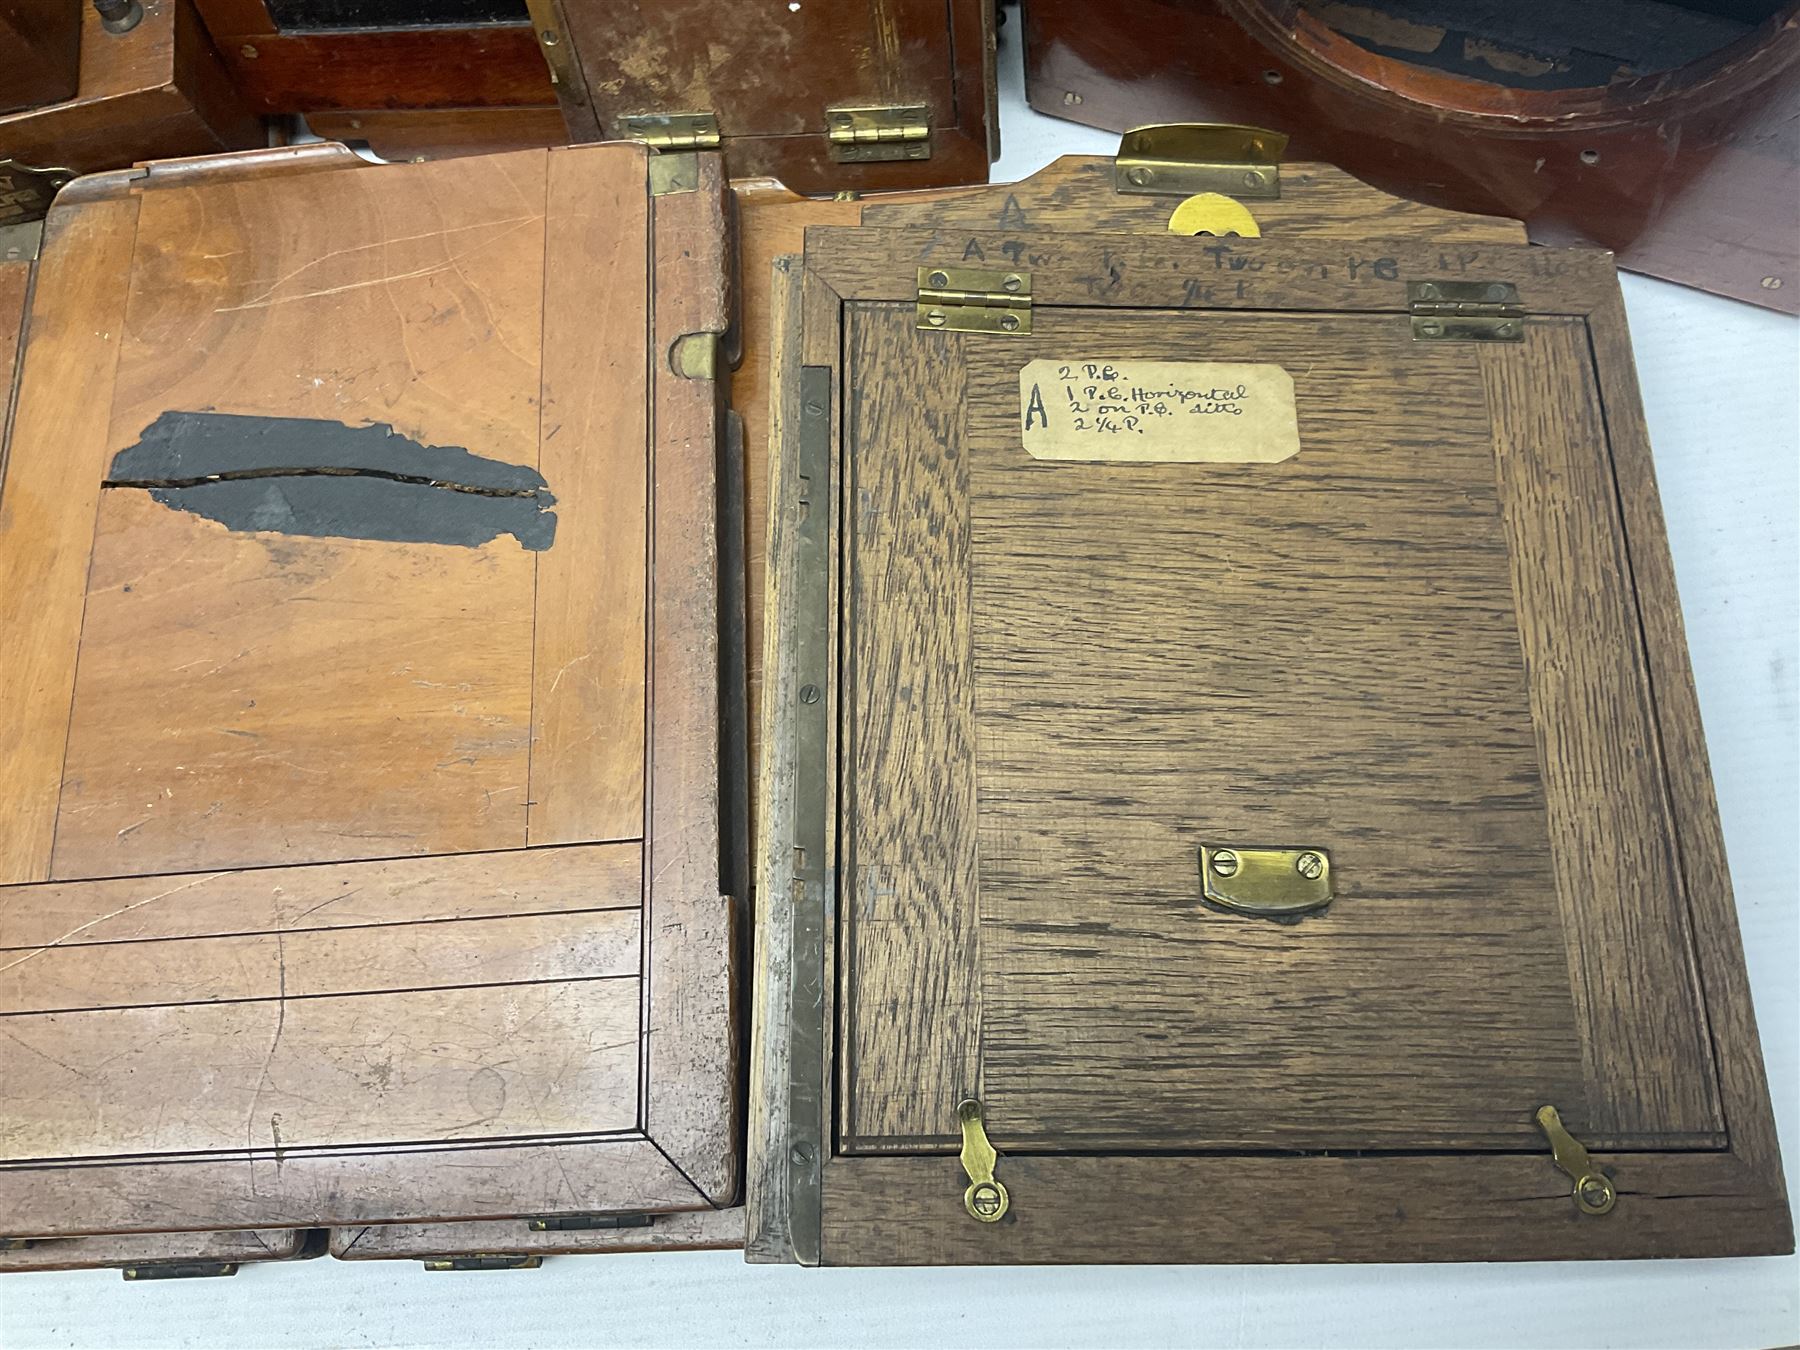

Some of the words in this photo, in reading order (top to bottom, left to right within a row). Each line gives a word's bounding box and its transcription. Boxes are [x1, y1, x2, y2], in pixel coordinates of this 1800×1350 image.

[961, 236, 985, 262] A
[1066, 384, 1074, 401] 1
[1130, 382, 1249, 405] Horizontal
[1024, 382, 1048, 431] A
[1069, 401, 1090, 413] 2
[1098, 405, 1131, 415] on
[1189, 402, 1243, 416] ditto
[1073, 417, 1094, 431] 2
